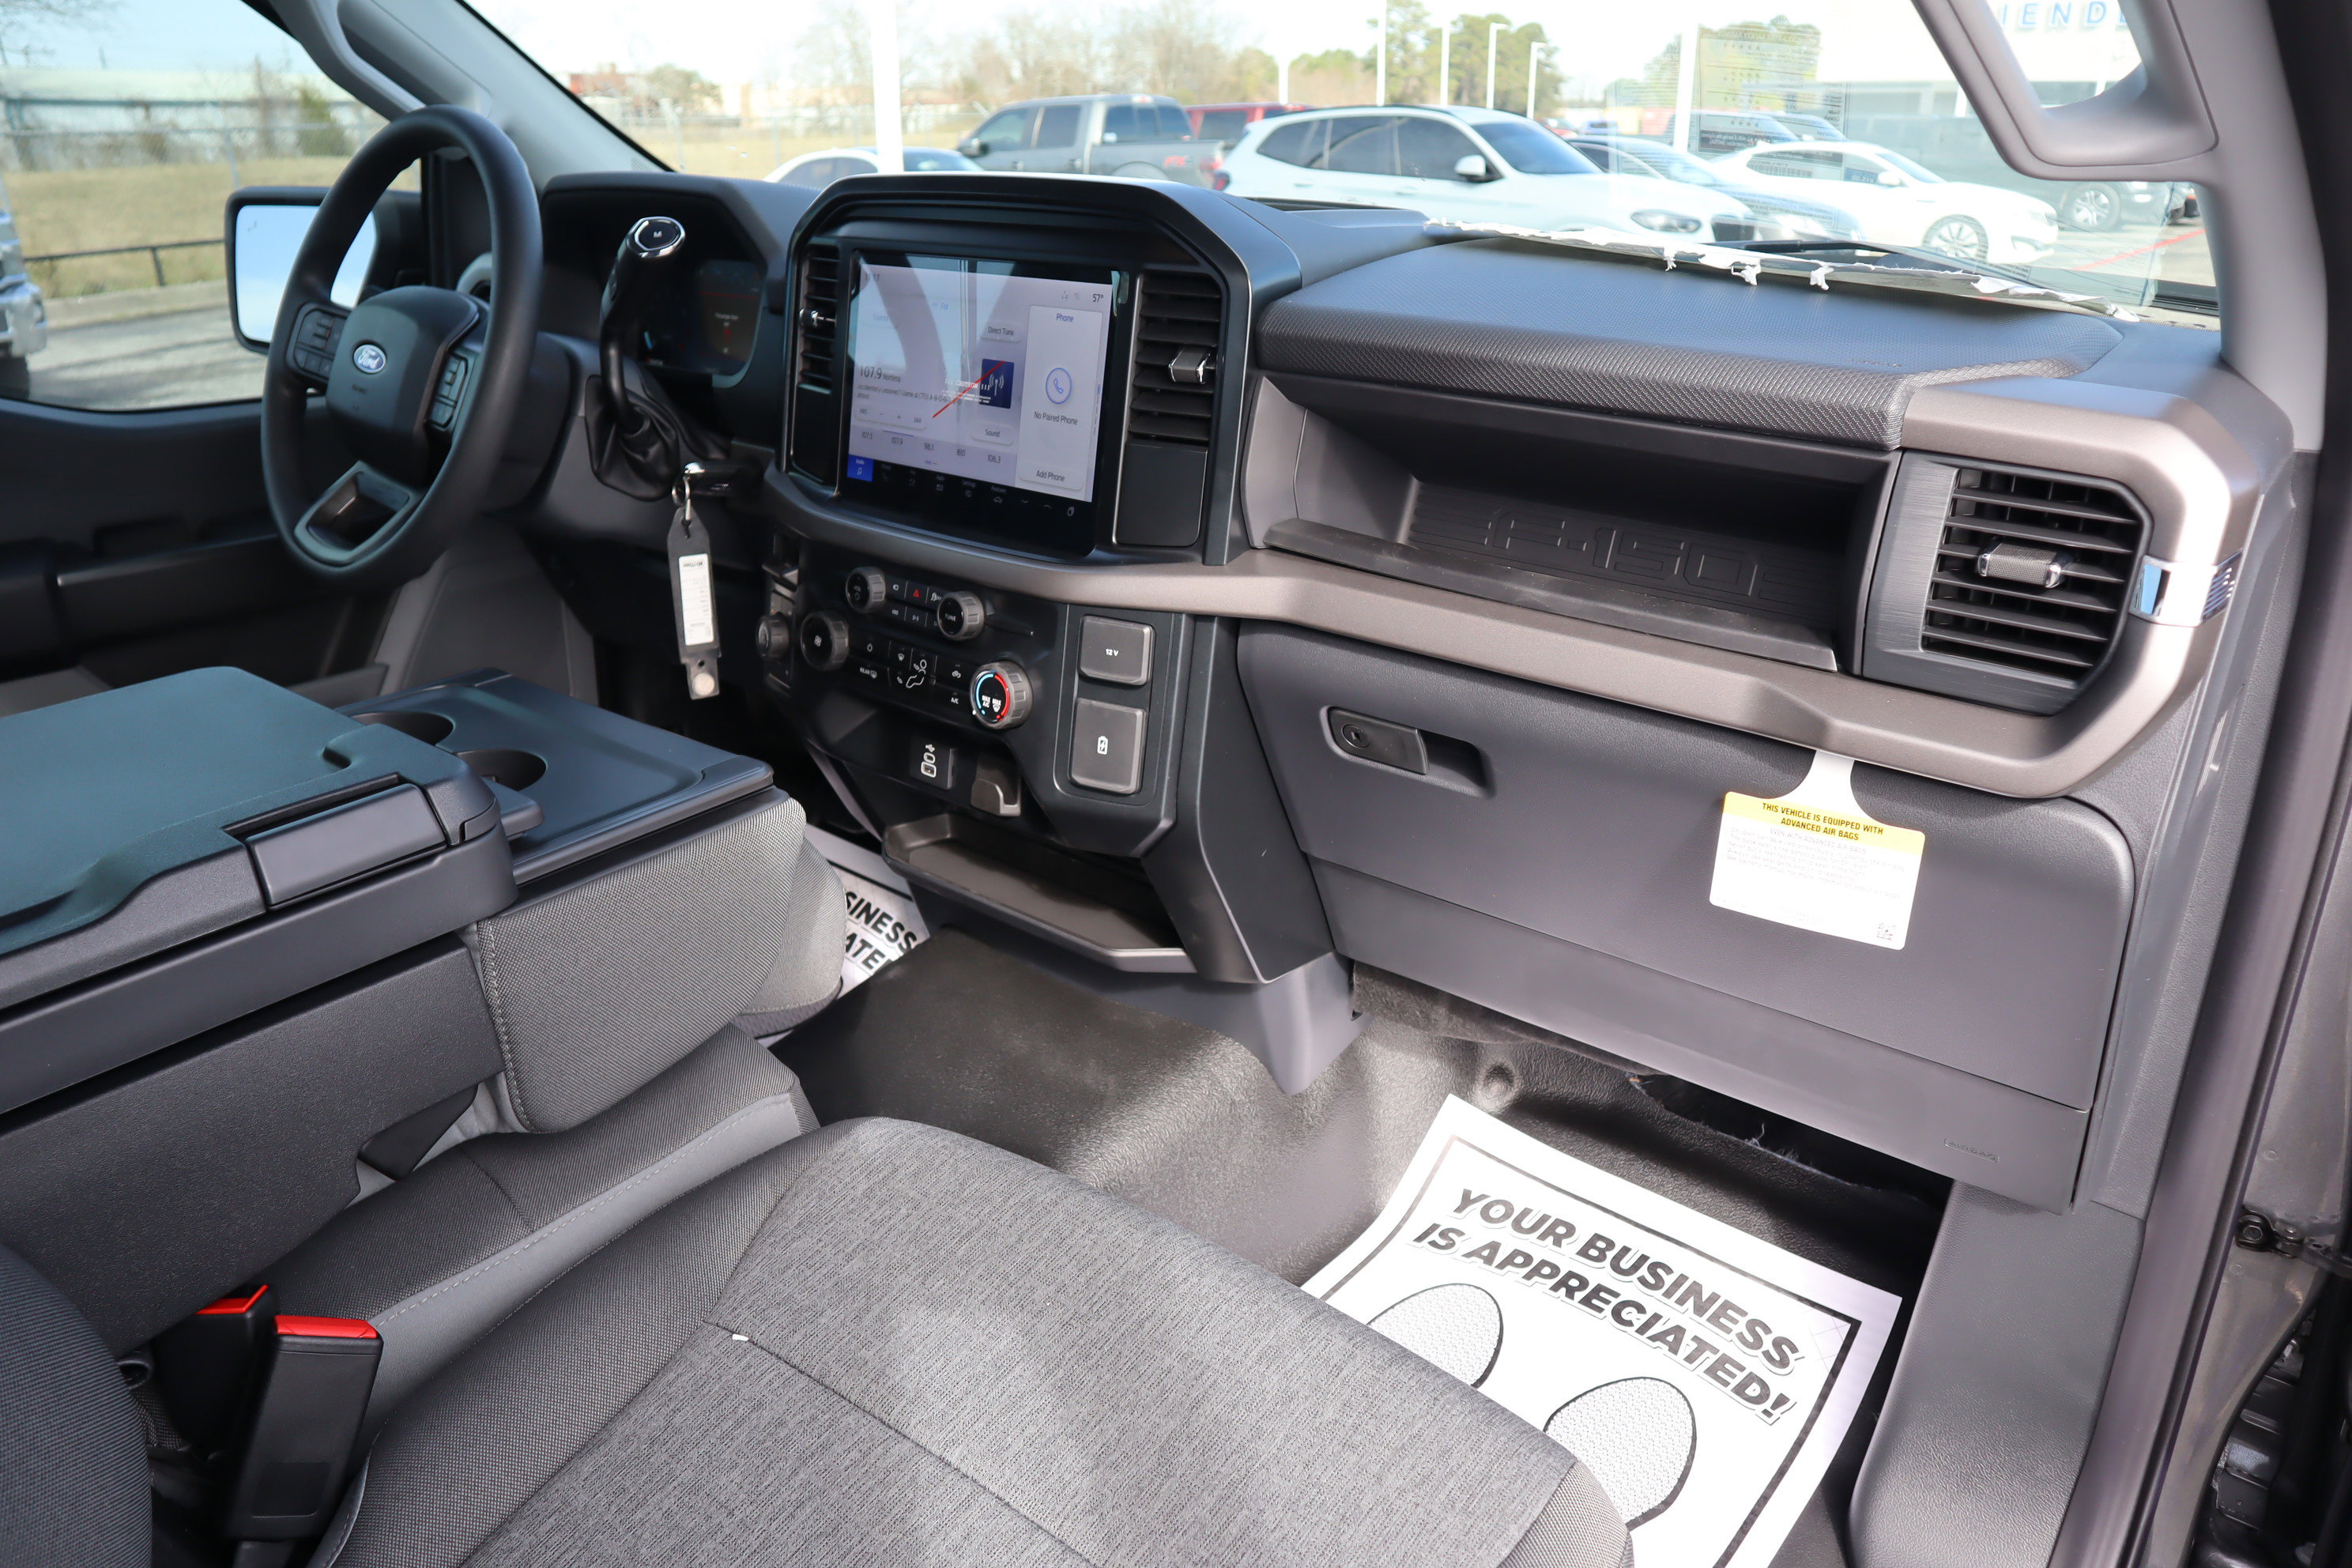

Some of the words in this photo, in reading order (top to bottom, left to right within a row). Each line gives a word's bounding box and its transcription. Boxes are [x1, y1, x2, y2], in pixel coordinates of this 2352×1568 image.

[1056, 313, 1074, 322] Phone
[988, 326, 1001, 335] Direct
[1002, 327, 1015, 336] Tune
[356, 346, 383, 371] Ford
[860, 366, 883, 379] 107.9
[1034, 411, 1042, 420] No
[1043, 412, 1060, 423] Paired
[1060, 414, 1079, 425] Phone
[985, 428, 1001, 438] Sound
[1036, 469, 1046, 478] Add
[1047, 470, 1065, 482] Phone
[1762, 802, 1779, 812] THIS
[1781, 806, 1811, 820] VEHICLE
[1813, 813, 1821, 822] IS
[1822, 816, 1860, 831] EQUIPPED
[1863, 824, 1883, 835] WITH
[1781, 817, 1821, 832] ADVANCED
[1823, 827, 1836, 836] AIR
[1838, 829, 1860, 841] BAGS
[1770, 827, 1785, 836] EVEN
[1803, 835, 1835, 848] ADVANCED
[1849, 845, 1866, 854] BAGS
[1449, 1188, 1578, 1250] YOUR
[1575, 1231, 1805, 1377] BUSINESS
[1408, 1222, 1468, 1252] IS
[1461, 1241, 1799, 1425] APPRECIATED!
